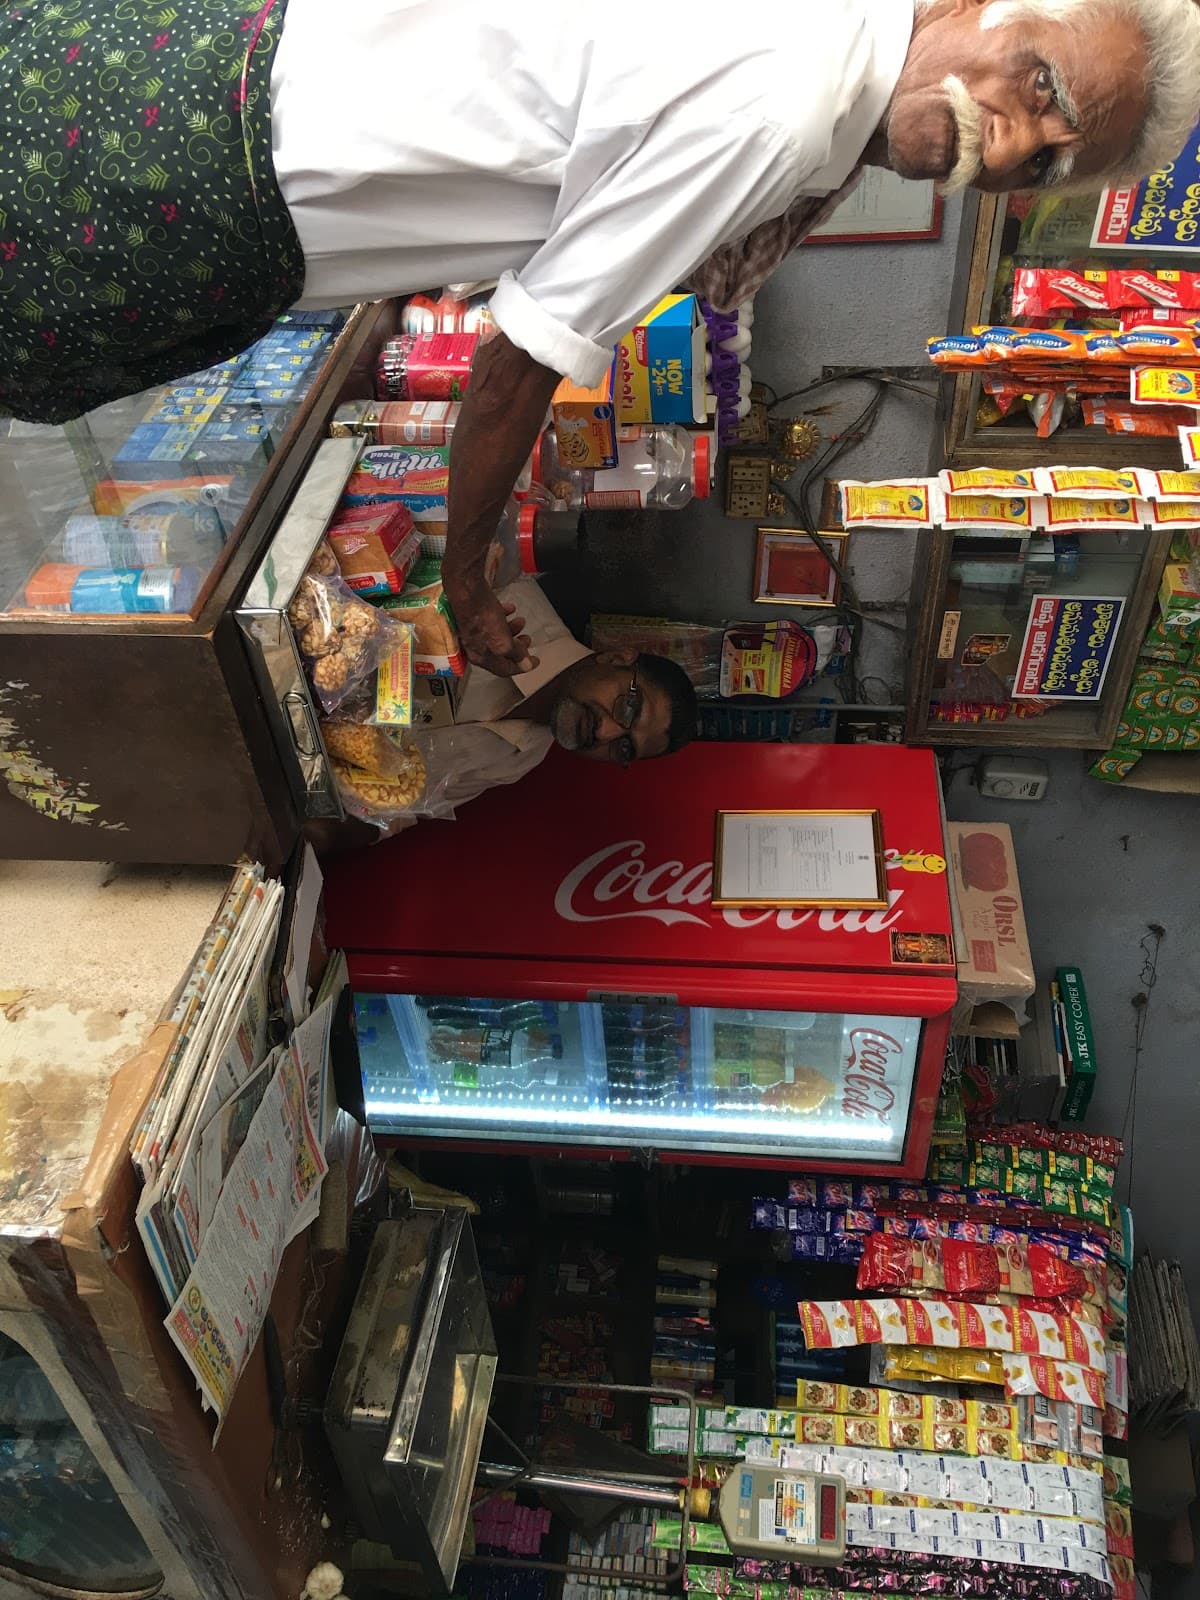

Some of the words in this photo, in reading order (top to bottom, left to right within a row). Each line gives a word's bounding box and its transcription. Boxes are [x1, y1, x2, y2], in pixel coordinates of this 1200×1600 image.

[1059, 276, 1105, 300] Boost
[1131, 274, 1178, 298] Boost
[935, 342, 978, 350] Horlicks
[652, 368, 666, 384] 24
[666, 359, 683, 395] NOW
[369, 452, 400, 460] Bread
[371, 453, 444, 480] milk
[992, 896, 1018, 947] ORSL
[1068, 986, 1083, 1018] COPIER
[1074, 1020, 1086, 1040] EASY
[1078, 1042, 1090, 1058] JK
[842, 1028, 904, 1124] Coca-Cola
